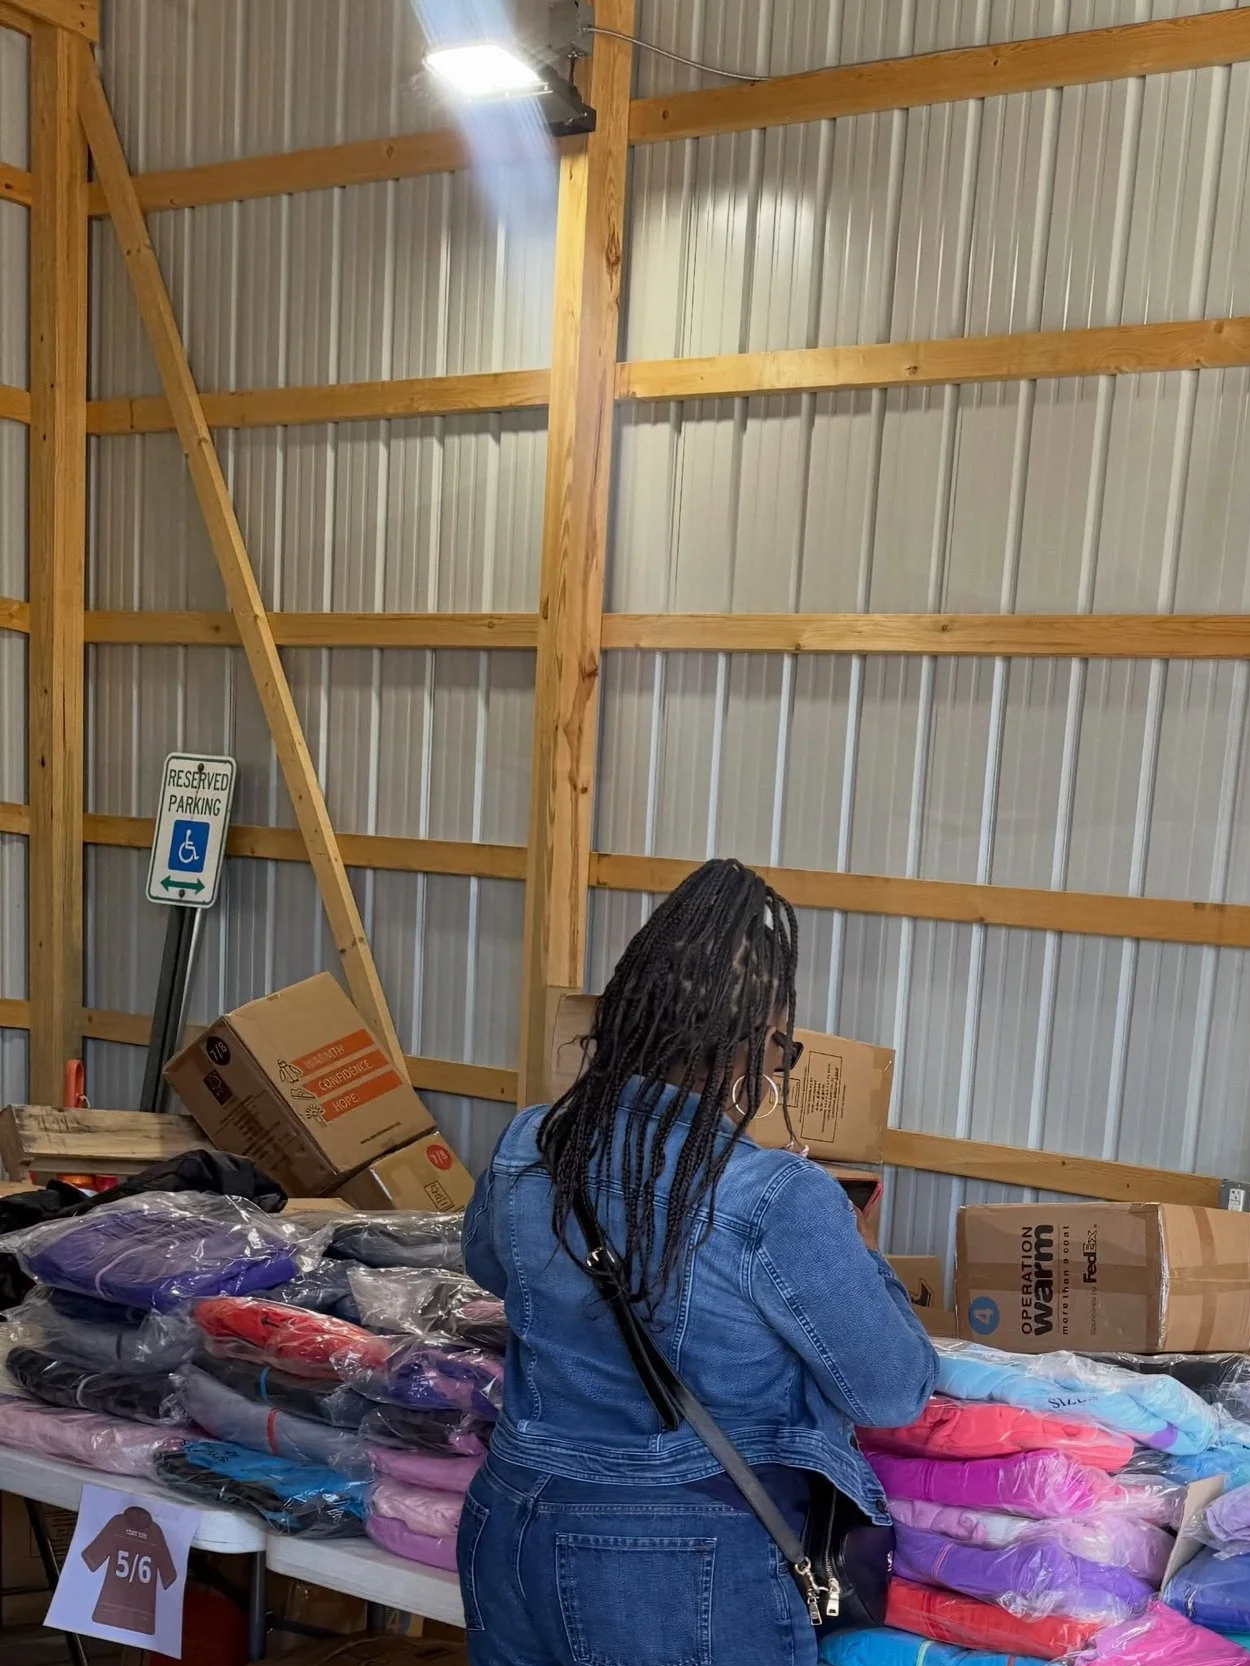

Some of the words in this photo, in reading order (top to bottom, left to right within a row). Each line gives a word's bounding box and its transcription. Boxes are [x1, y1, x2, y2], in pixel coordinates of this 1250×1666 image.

[168, 769, 229, 792] RESERVED
[168, 794, 222, 817] PARKING
[332, 1092, 358, 1113] HOPE
[1083, 1229, 1098, 1283] FedEx
[1021, 1226, 1033, 1335] OPERATION
[1034, 1224, 1054, 1336] warm
[973, 1307, 993, 1326] 4
[115, 1550, 152, 1584] 5/6
